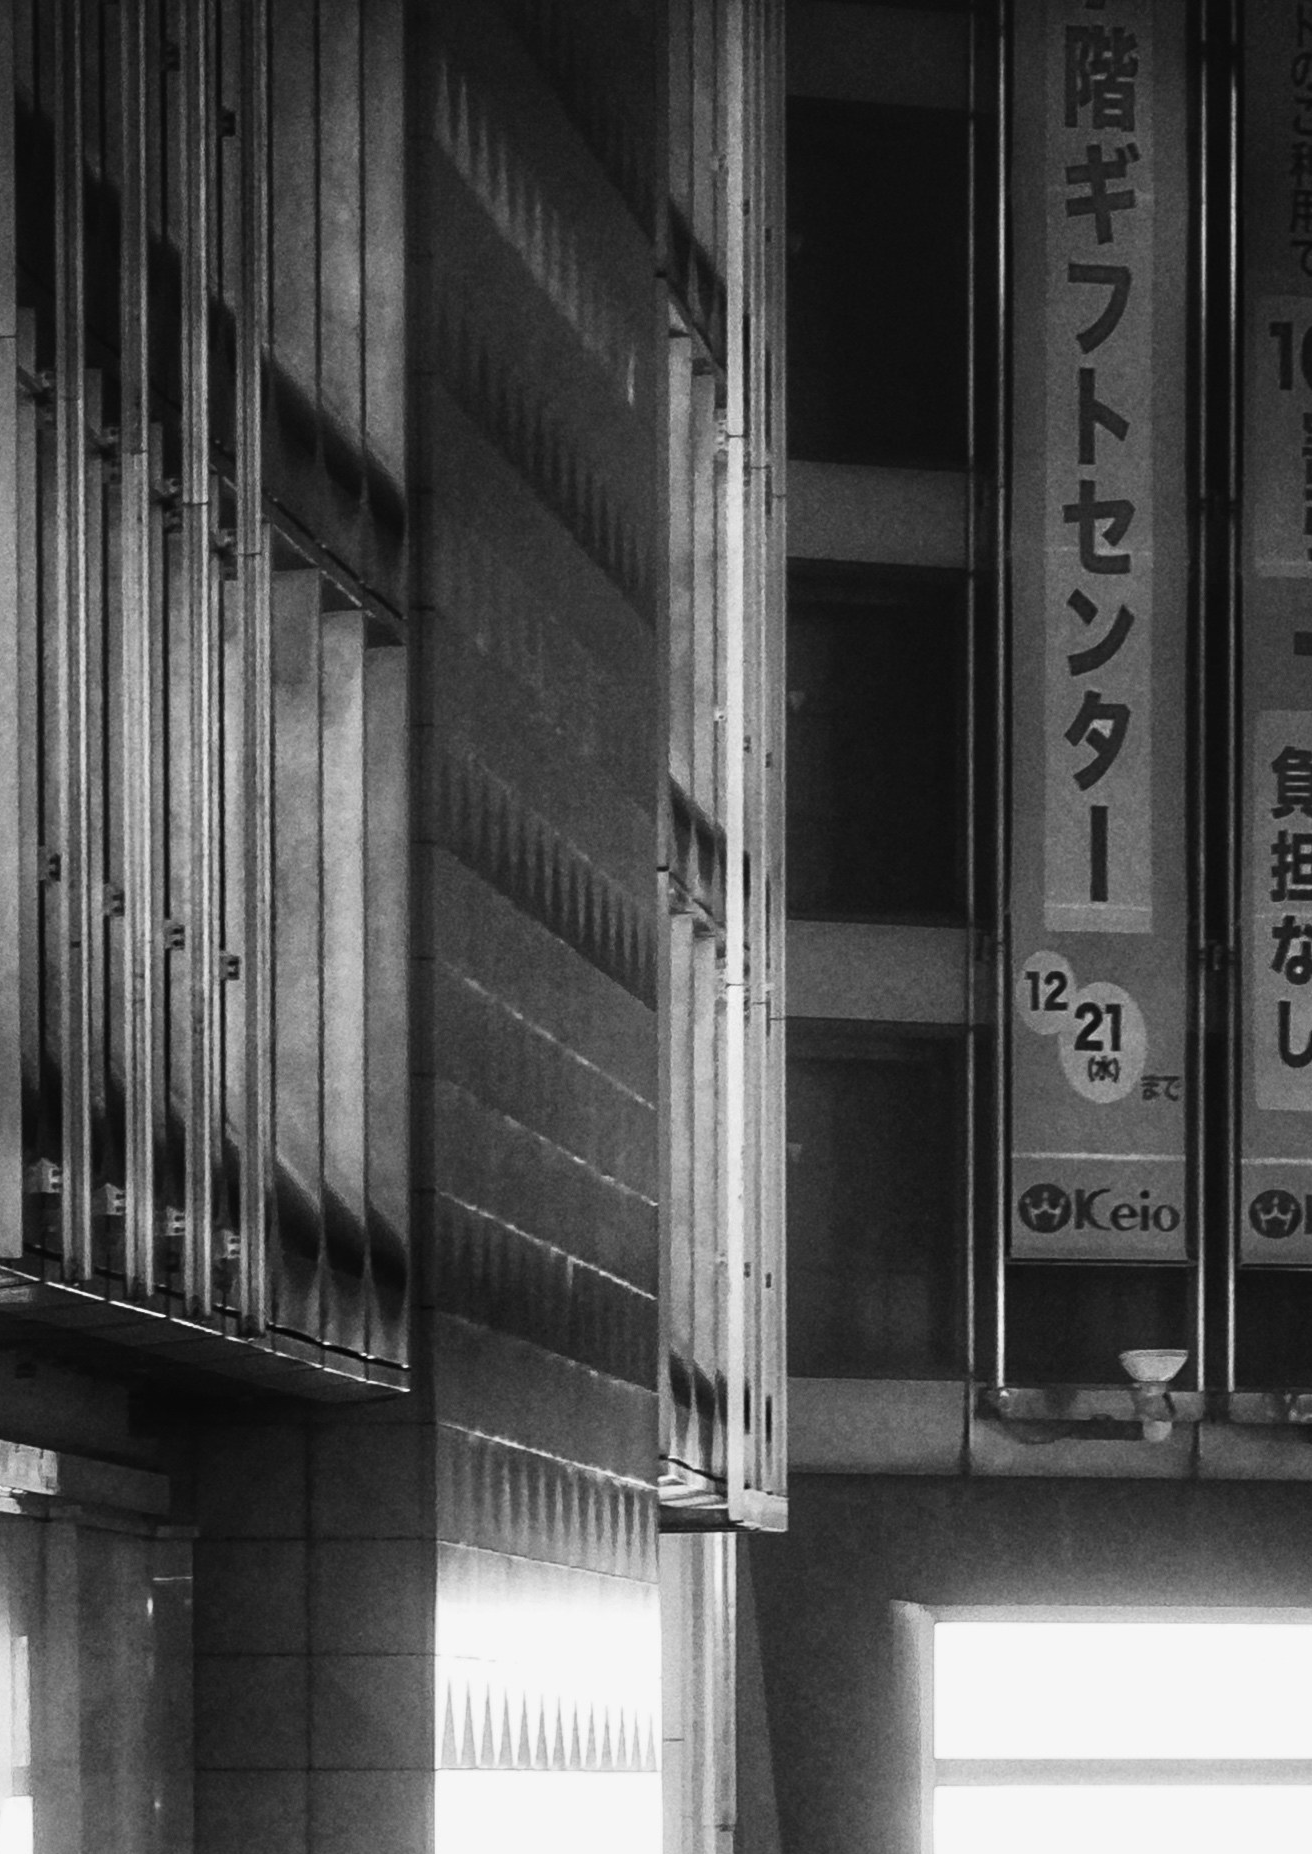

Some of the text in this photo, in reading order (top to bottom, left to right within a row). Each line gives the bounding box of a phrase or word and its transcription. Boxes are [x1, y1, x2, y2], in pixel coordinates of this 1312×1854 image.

[1063, 0, 1141, 903] 階ギフトセンター
[1024, 970, 1069, 1012] 12
[1074, 1001, 1122, 1052] 21
[1140, 1074, 1181, 1101] まで
[1074, 1187, 1182, 1233] Keio
